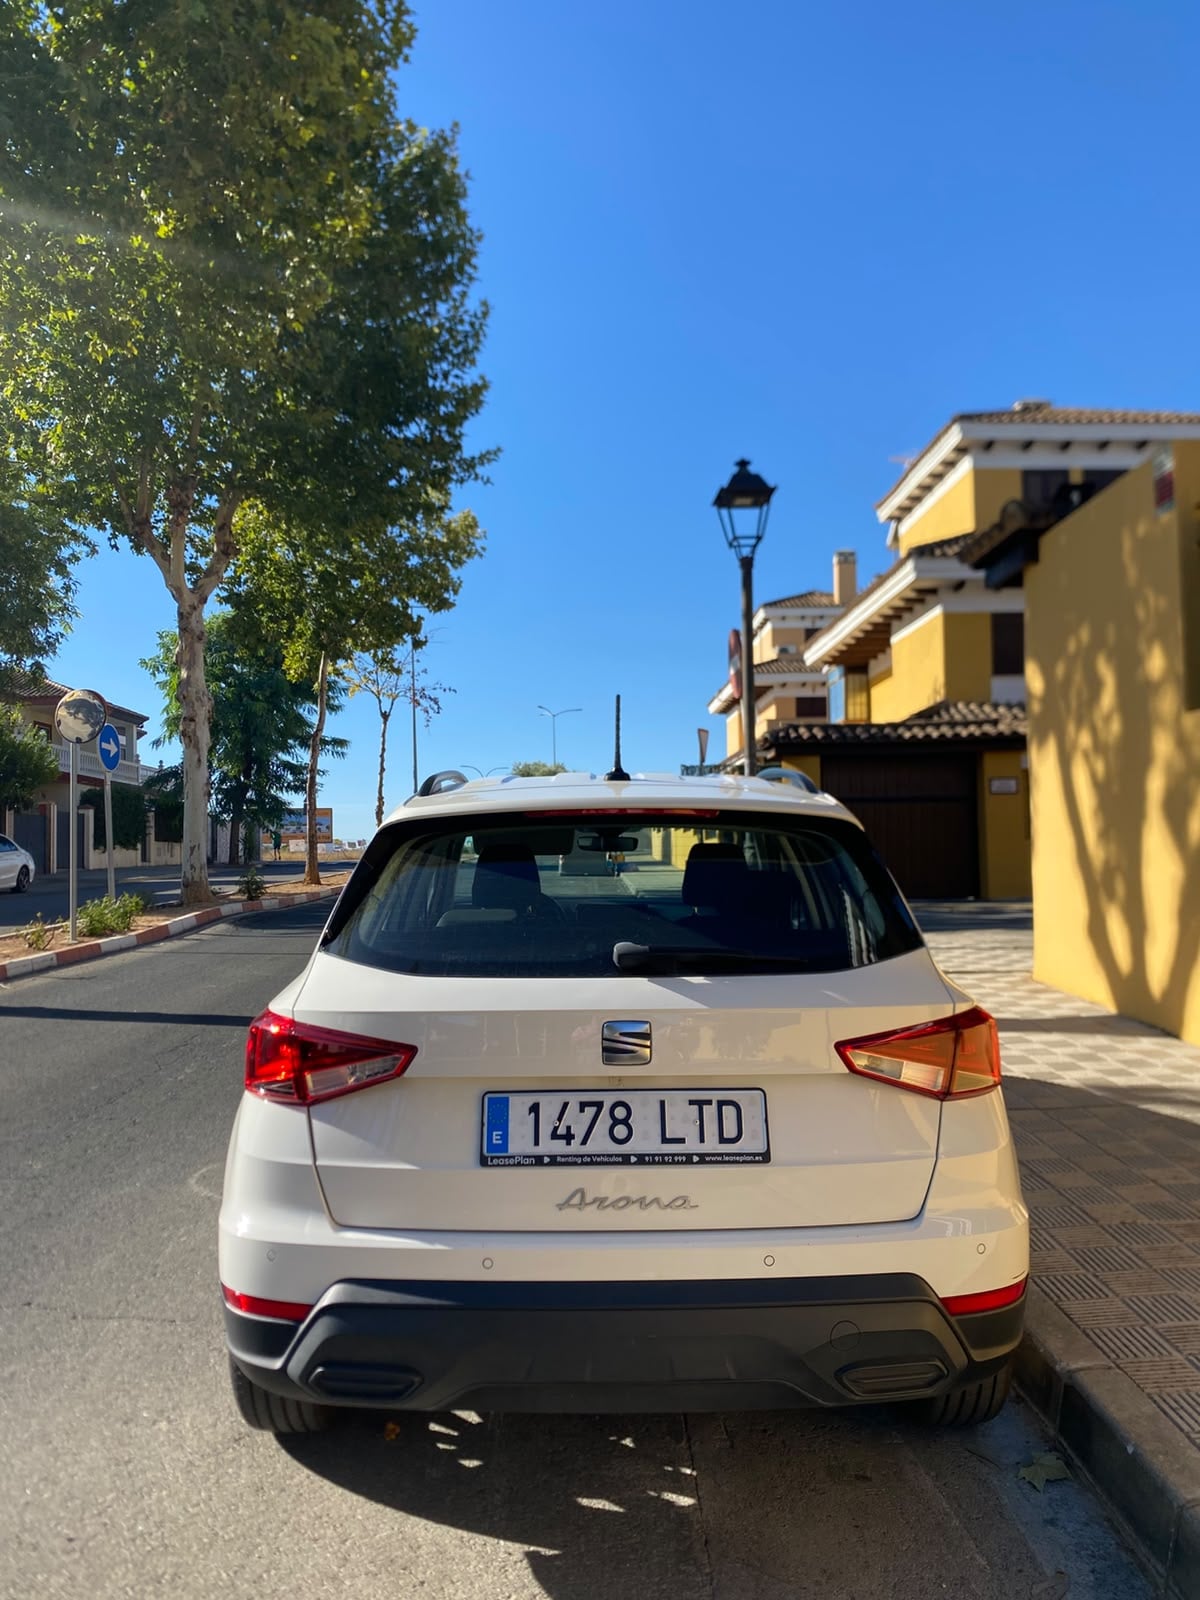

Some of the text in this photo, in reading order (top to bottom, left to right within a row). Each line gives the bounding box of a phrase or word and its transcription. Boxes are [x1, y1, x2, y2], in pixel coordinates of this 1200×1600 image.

[528, 1099, 743, 1147] 1478 LTD
[492, 1131, 503, 1144] E
[487, 1156, 536, 1166] LeasePlan
[556, 1156, 582, 1165] Renting
[582, 1155, 590, 1163] de
[704, 1155, 763, 1163] www.leaseplan.es
[555, 1187, 699, 1211] Arona
